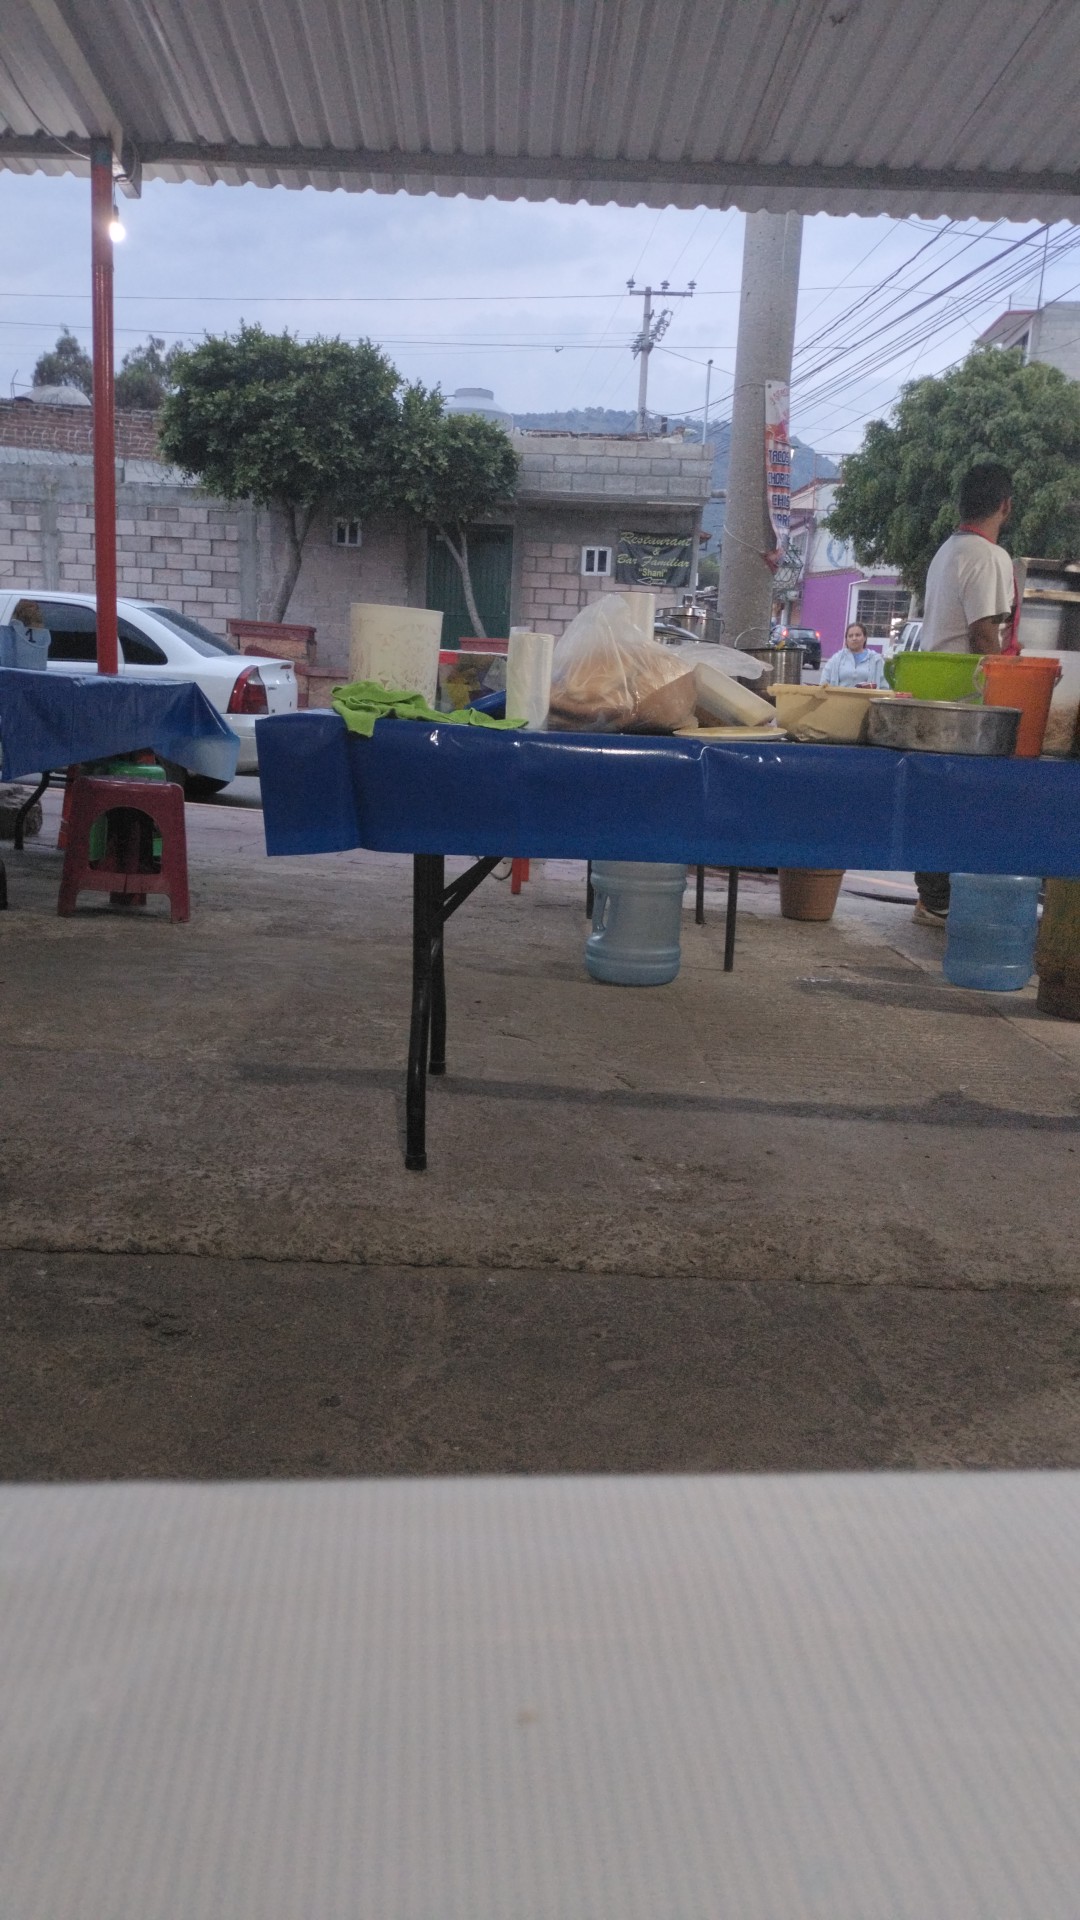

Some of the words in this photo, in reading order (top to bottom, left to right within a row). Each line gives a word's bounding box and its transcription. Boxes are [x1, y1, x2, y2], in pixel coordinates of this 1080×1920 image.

[618, 532, 693, 546] Restaurant
[652, 547, 660, 556] &
[616, 553, 638, 564] Bar
[641, 556, 690, 567] Familiar
[25, 628, 36, 643] 1
